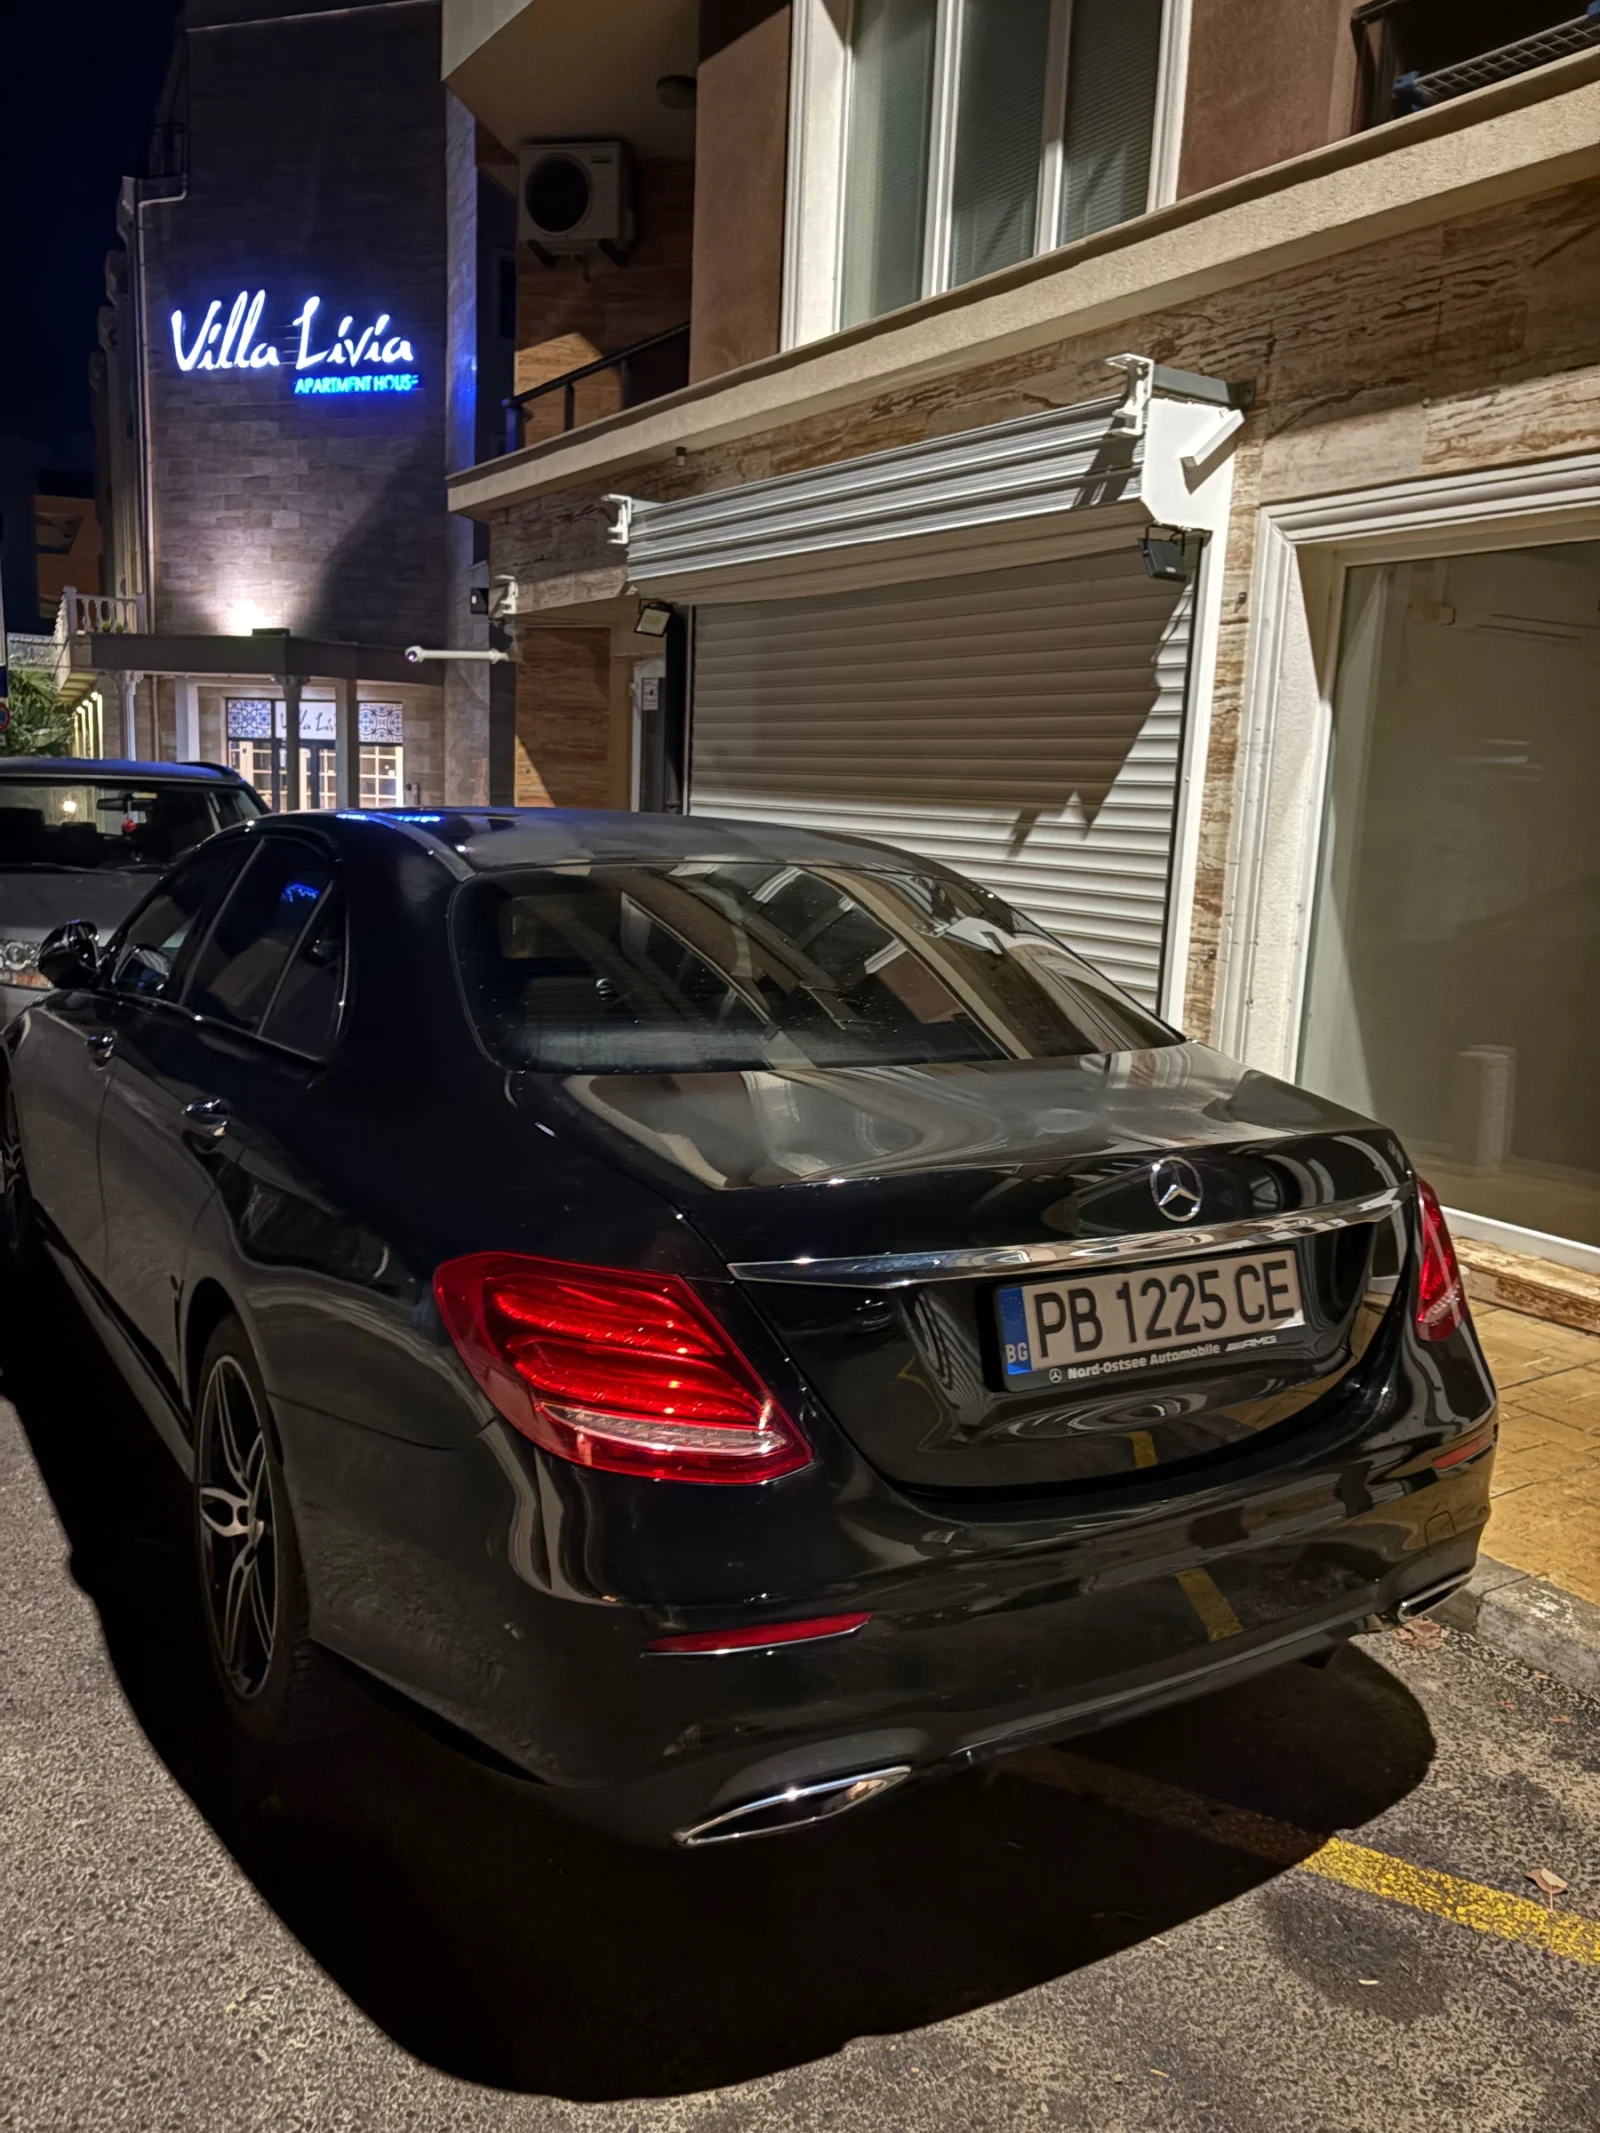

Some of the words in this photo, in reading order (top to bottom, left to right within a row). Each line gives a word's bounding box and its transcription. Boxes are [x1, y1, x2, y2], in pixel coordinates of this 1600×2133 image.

[171, 289, 280, 371] Villa
[292, 296, 414, 370] Livia
[1033, 1288, 1103, 1358] PB
[1116, 1270, 1228, 1343] 1225
[1234, 1259, 1295, 1324] CE
[1004, 1342, 1028, 1364] BG
[1067, 1358, 1147, 1379] Nord-Ostsee
[1150, 1342, 1221, 1365] Automobile
[1238, 1335, 1277, 1348] AMG
